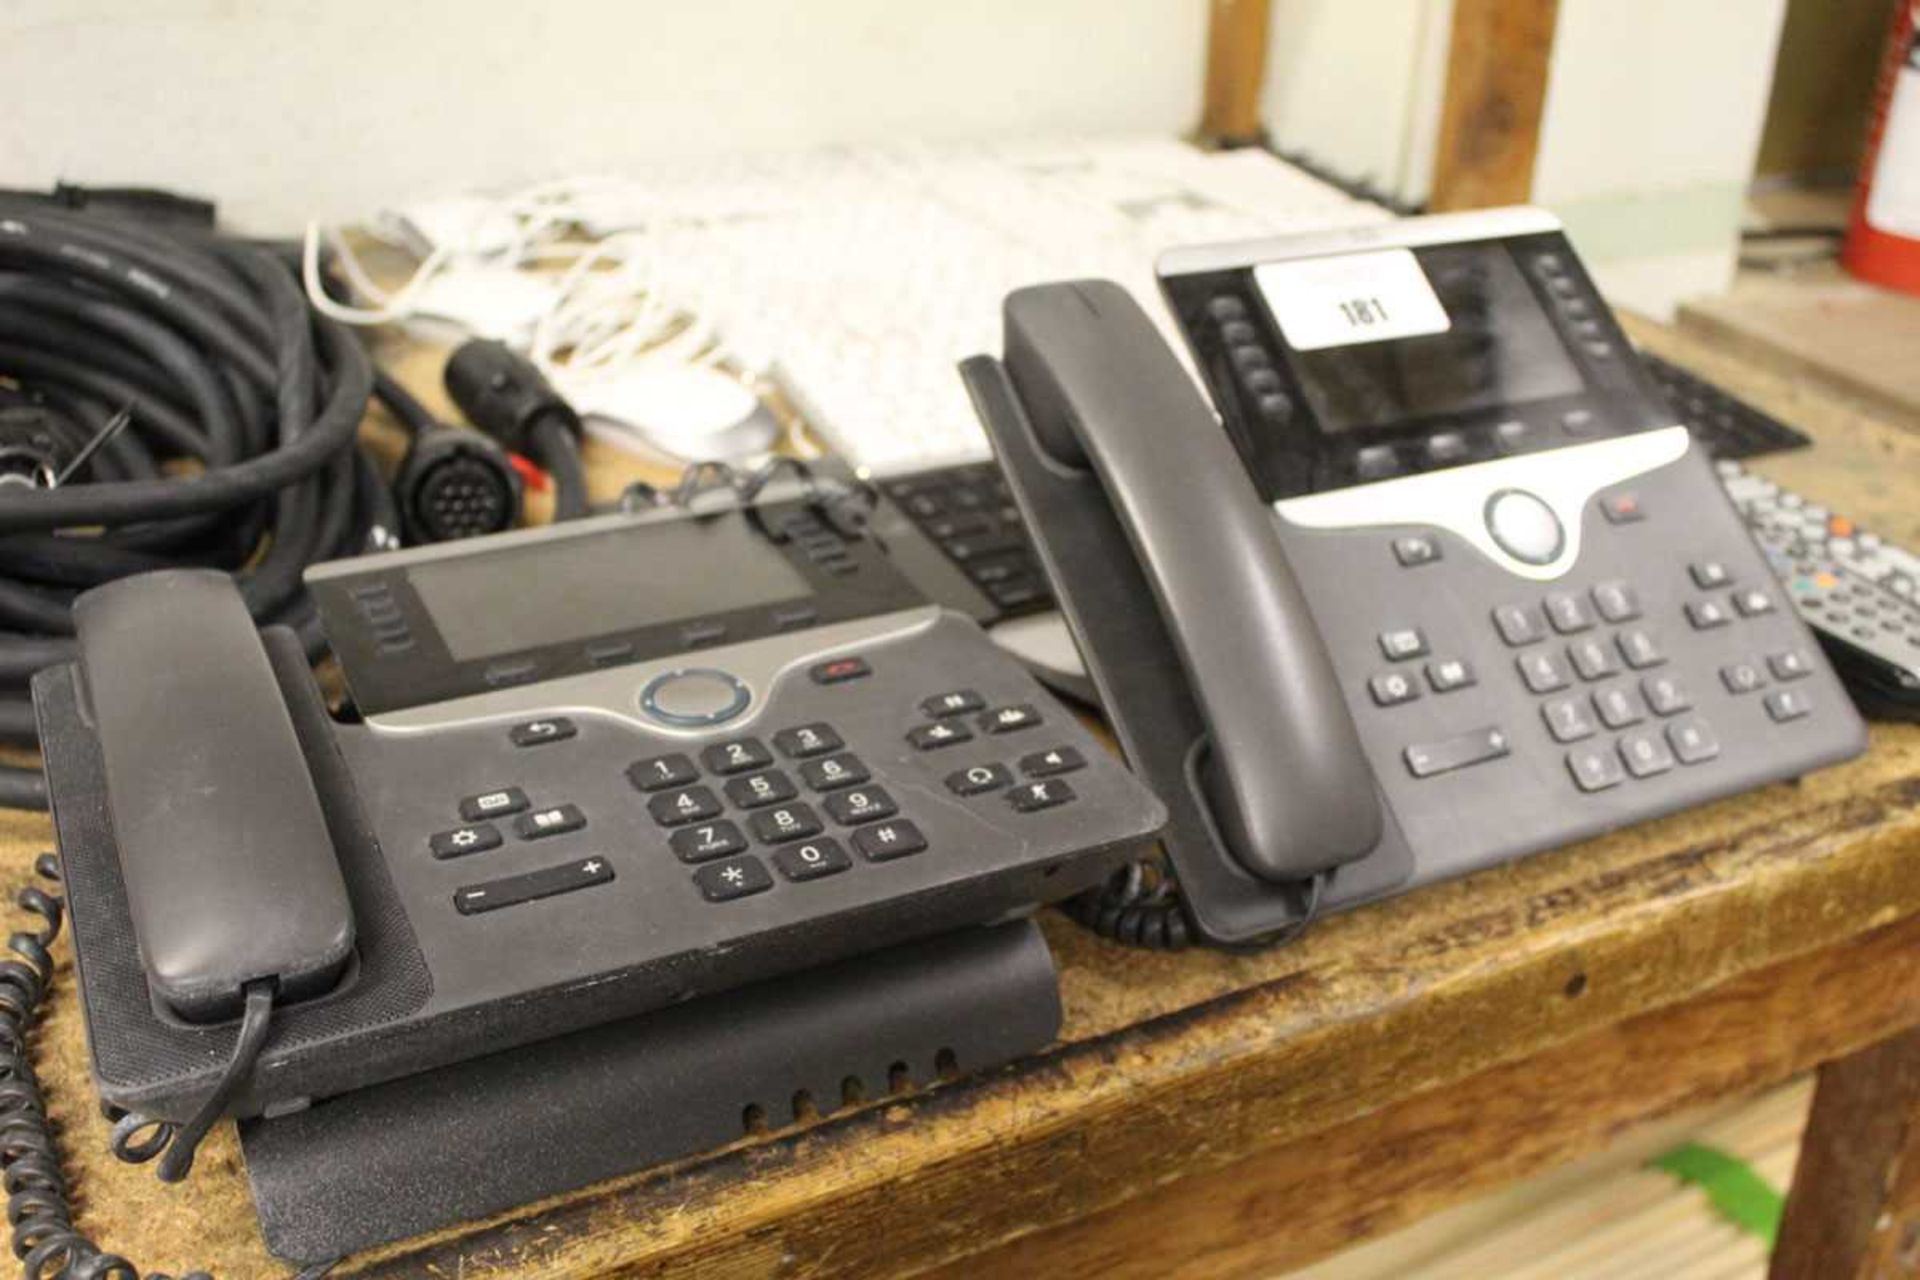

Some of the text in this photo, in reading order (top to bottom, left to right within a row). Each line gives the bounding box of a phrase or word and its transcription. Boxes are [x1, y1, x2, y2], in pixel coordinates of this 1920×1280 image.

[1339, 297, 1389, 326] 181
[797, 729, 818, 744] 3
[726, 743, 745, 759] 2
[654, 760, 670, 775] 1
[822, 760, 842, 775] 6
[749, 777, 769, 792] 5
[677, 793, 695, 807] 4
[848, 793, 868, 808] 9
[774, 810, 794, 826] 8
[697, 827, 714, 843] 7
[800, 845, 820, 861] 0
